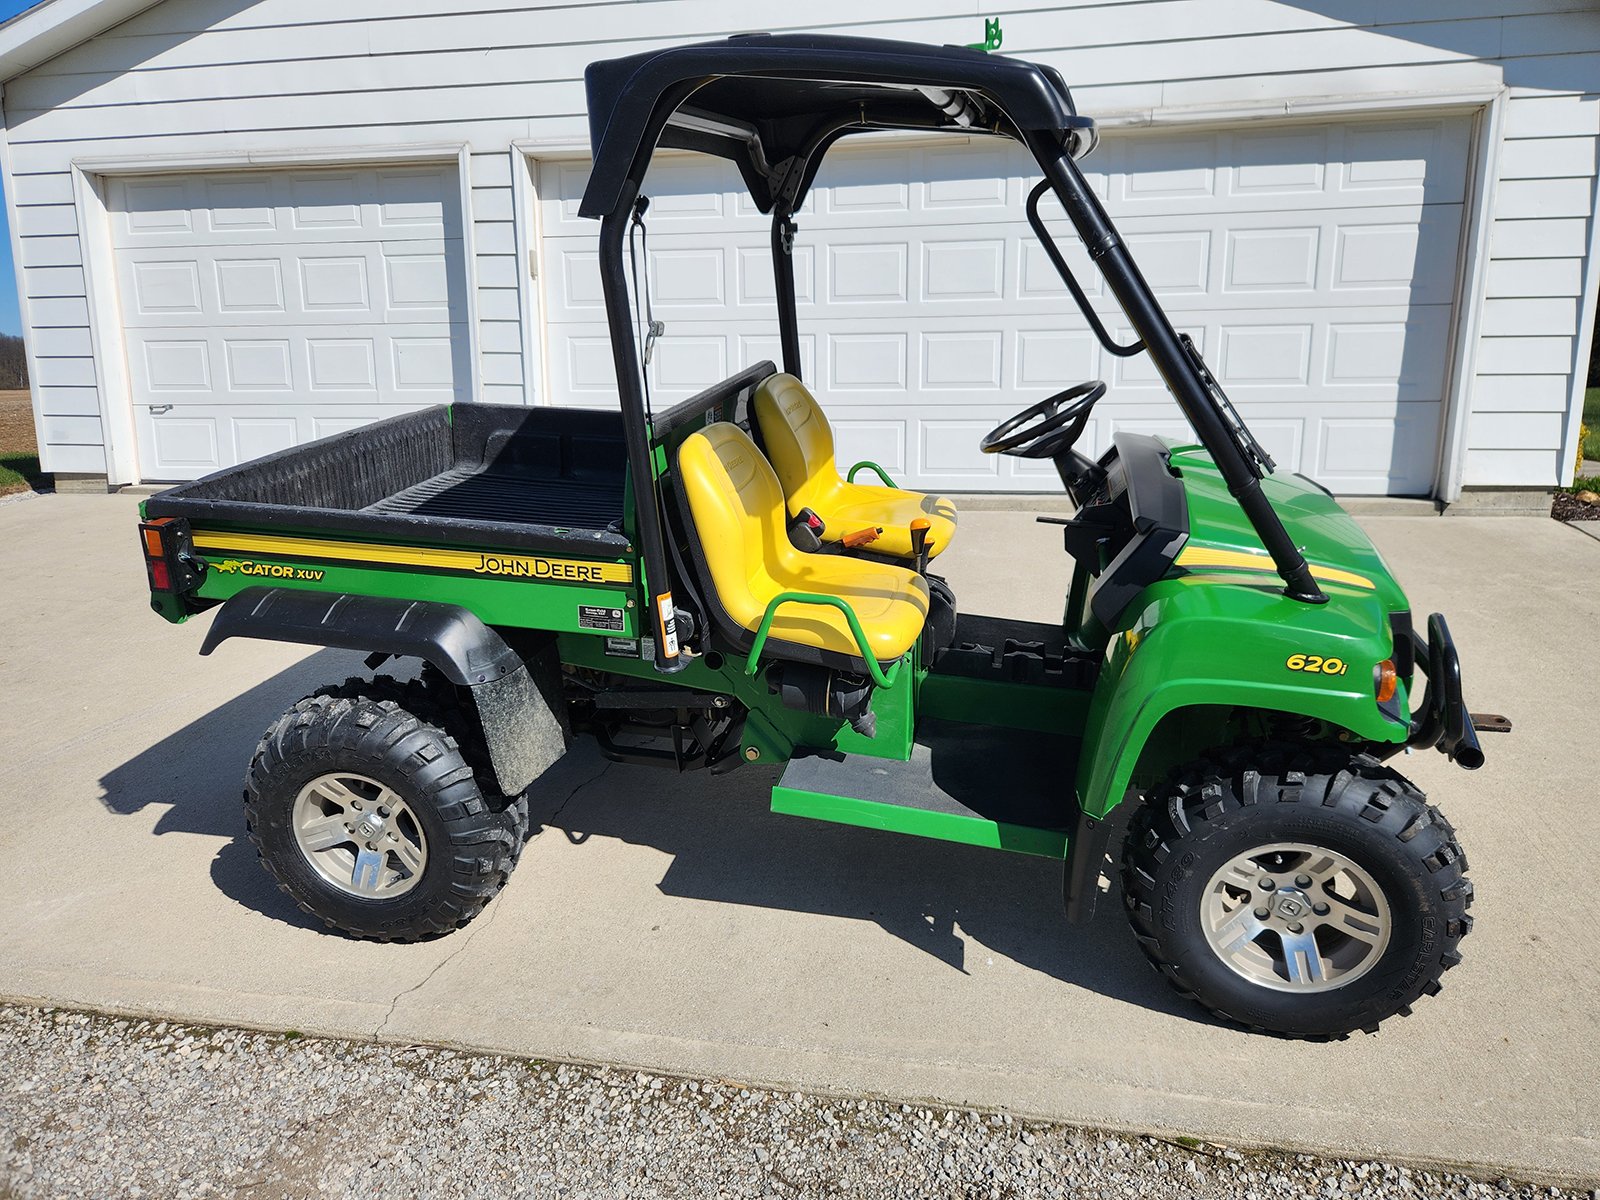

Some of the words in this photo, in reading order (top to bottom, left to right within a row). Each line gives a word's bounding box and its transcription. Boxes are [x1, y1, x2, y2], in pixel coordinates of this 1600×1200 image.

[240, 561, 294, 578] GATOR
[296, 569, 324, 580] XUV
[475, 555, 529, 574] JOHN
[535, 559, 602, 580] DEERE
[1286, 654, 1347, 675] 620i
